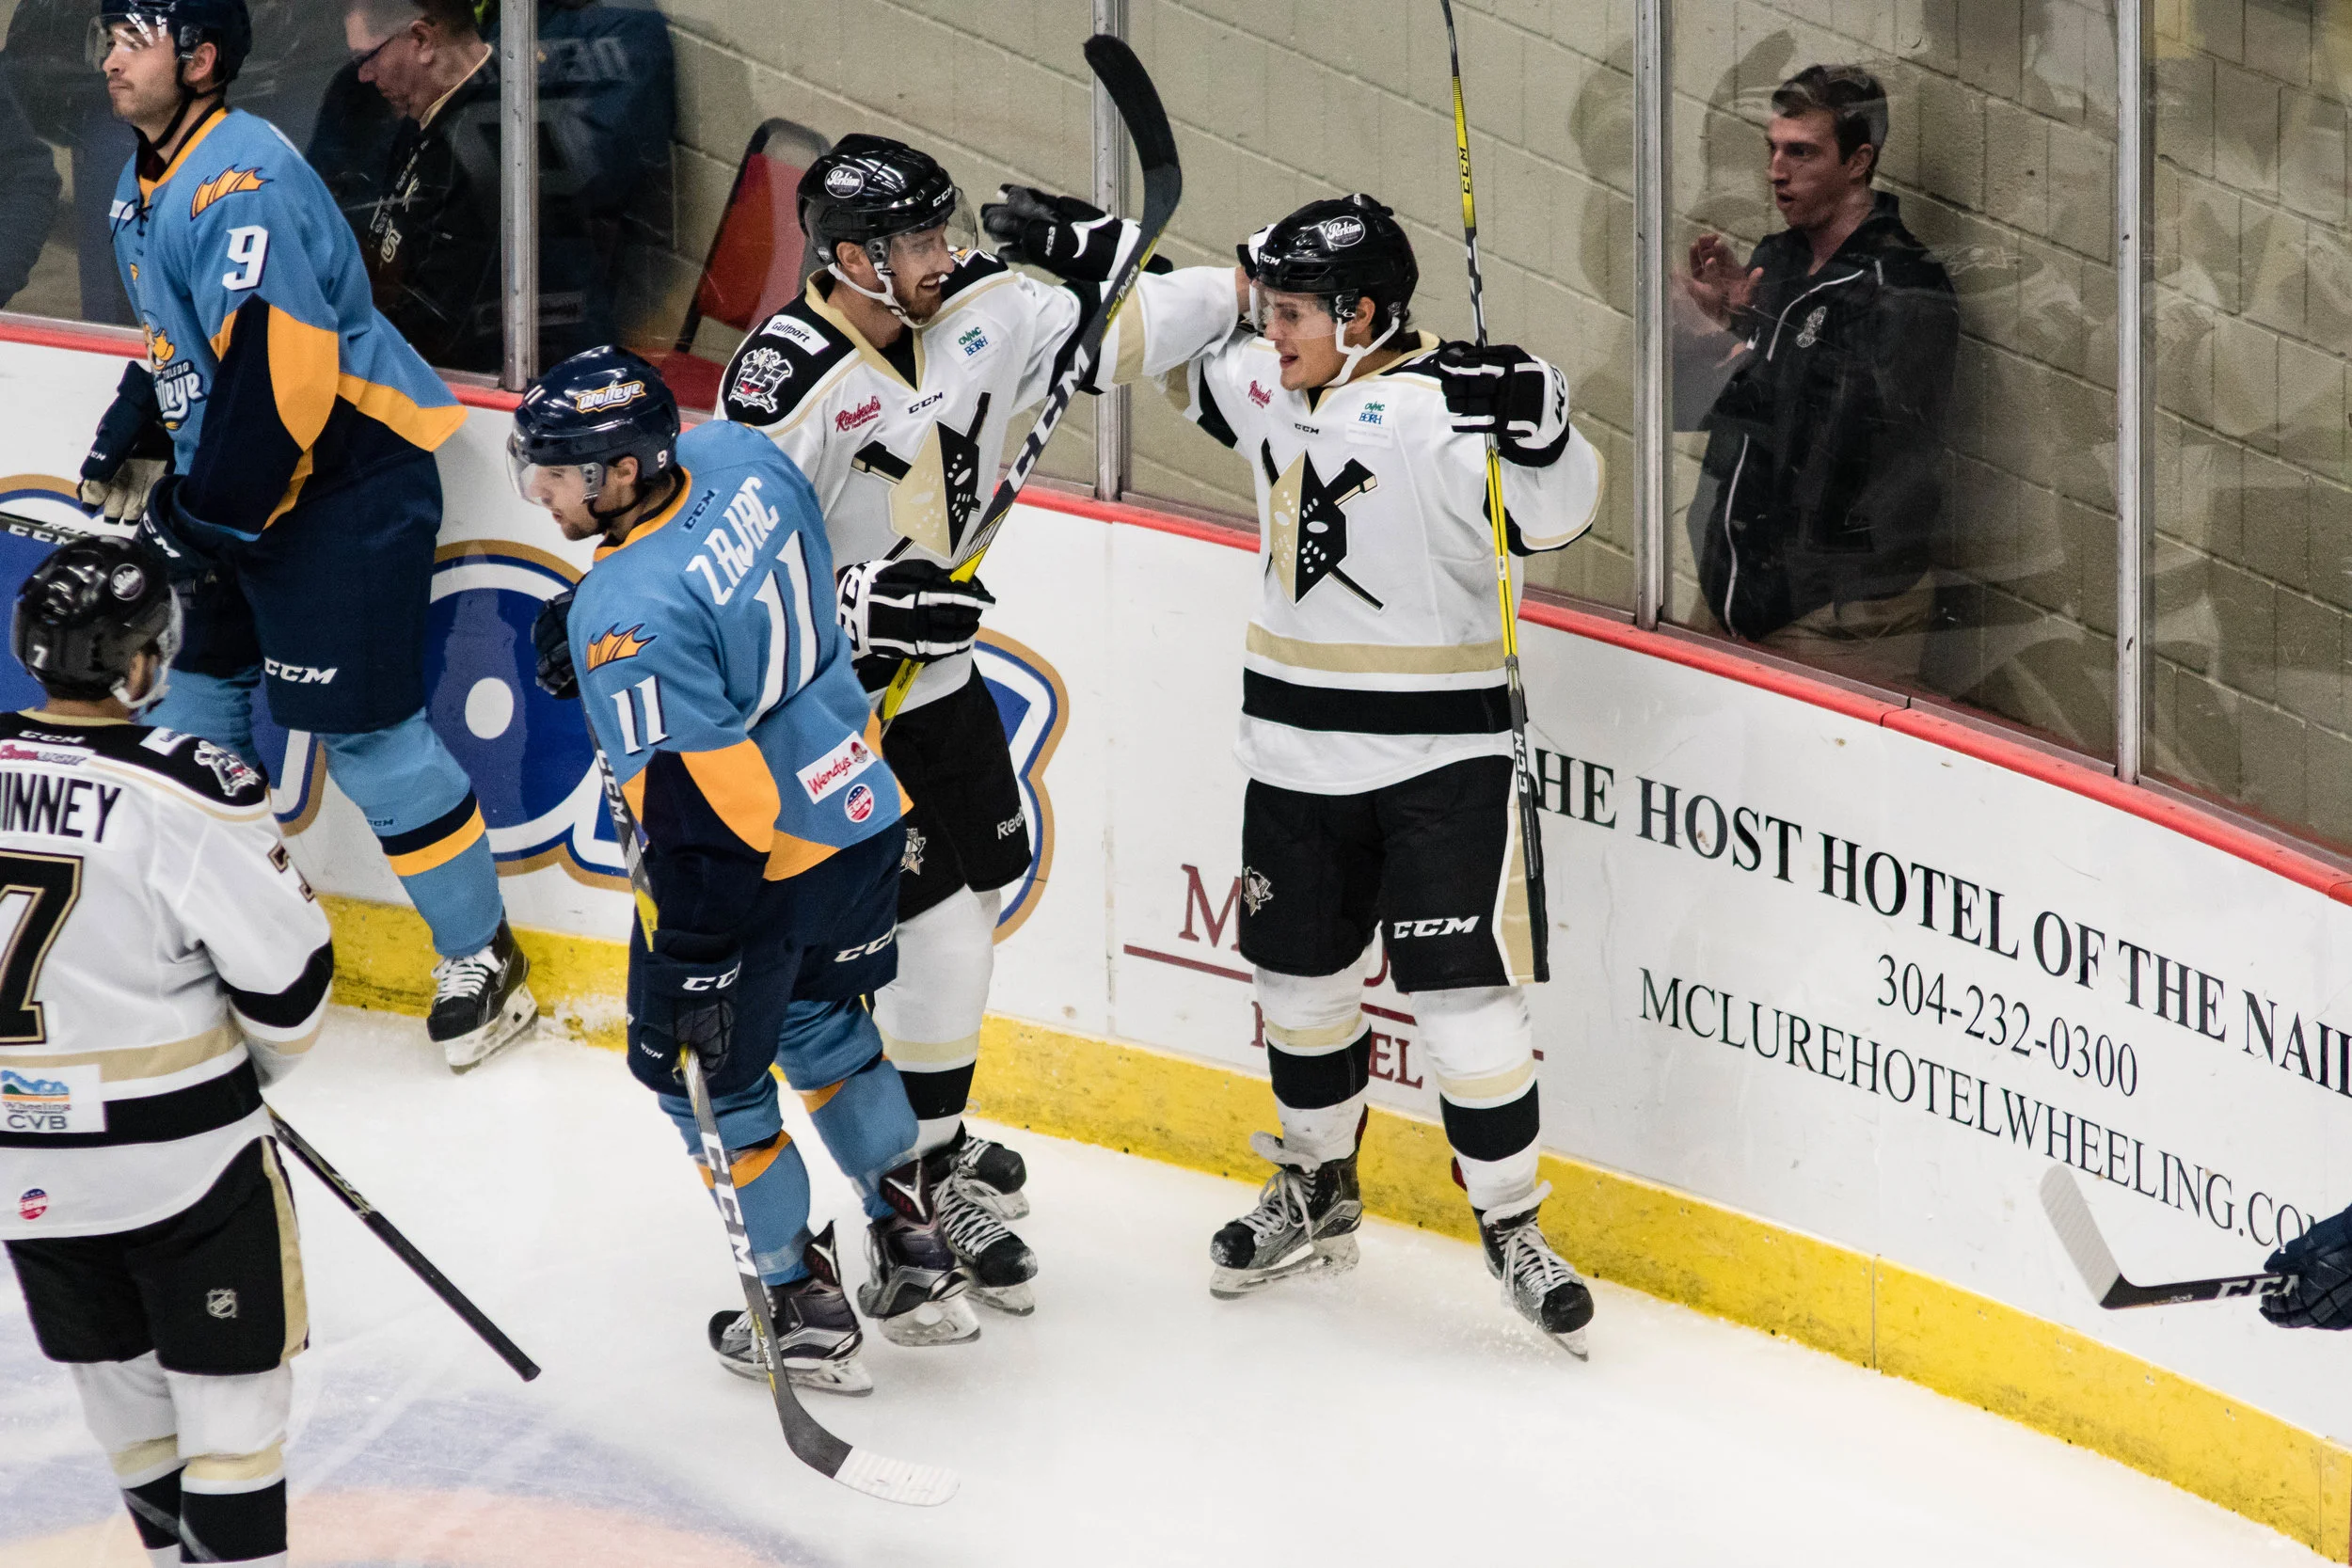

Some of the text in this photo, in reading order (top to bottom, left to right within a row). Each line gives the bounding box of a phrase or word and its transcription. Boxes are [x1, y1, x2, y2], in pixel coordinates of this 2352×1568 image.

[1459, 147, 1470, 195] CCM
[222, 225, 270, 292] 9
[1260, 251, 1281, 266] CCM
[771, 321, 811, 343] Gulfport
[908, 391, 943, 415] CCM
[1006, 343, 1090, 494] CCM
[1294, 423, 1320, 435] CCM
[683, 489, 716, 531] CCM
[685, 476, 781, 606] ZAJAC
[34, 644, 49, 669] 7
[744, 530, 821, 732] 11
[264, 657, 339, 686] CCM
[19, 730, 87, 744] CCM
[610, 674, 673, 756] 11
[596, 749, 628, 825] CCM
[1512, 732, 1529, 795] CCM
[0, 771, 122, 843] INNEY
[1534, 747, 1617, 830] HE
[1635, 774, 1803, 884] HOST
[1818, 832, 2020, 961] HOTEL
[2033, 911, 2106, 990] OF
[2117, 939, 2228, 1044] THE
[0, 848, 85, 1046] 7
[834, 920, 898, 963] CC
[1393, 915, 1481, 940] CCM
[682, 960, 741, 991] CC
[1876, 953, 2138, 1098] 304-232-0300
[8, 1114, 68, 1130] CVB
[1638, 967, 2317, 1247] MCLUREHOTELWHEELING.CO
[701, 1131, 759, 1278] CCM
